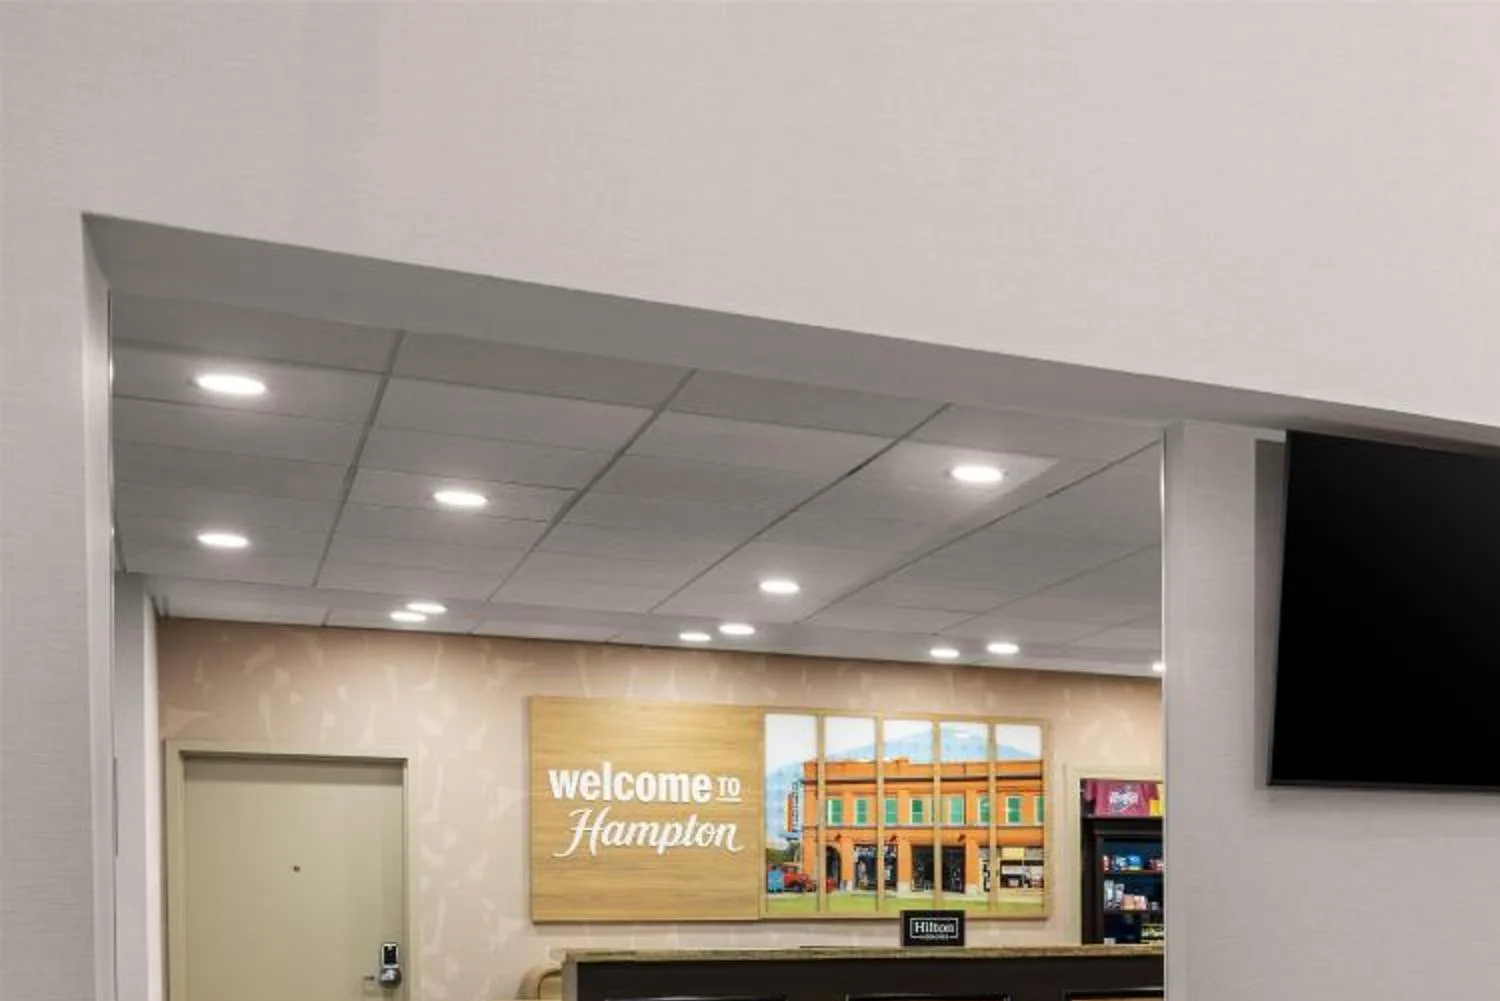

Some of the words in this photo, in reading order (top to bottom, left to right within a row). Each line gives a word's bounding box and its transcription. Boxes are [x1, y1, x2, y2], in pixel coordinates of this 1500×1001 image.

[548, 761, 713, 803] welcome
[717, 776, 742, 799] TO
[552, 806, 744, 858] Hampton
[914, 922, 954, 933] Hilton
